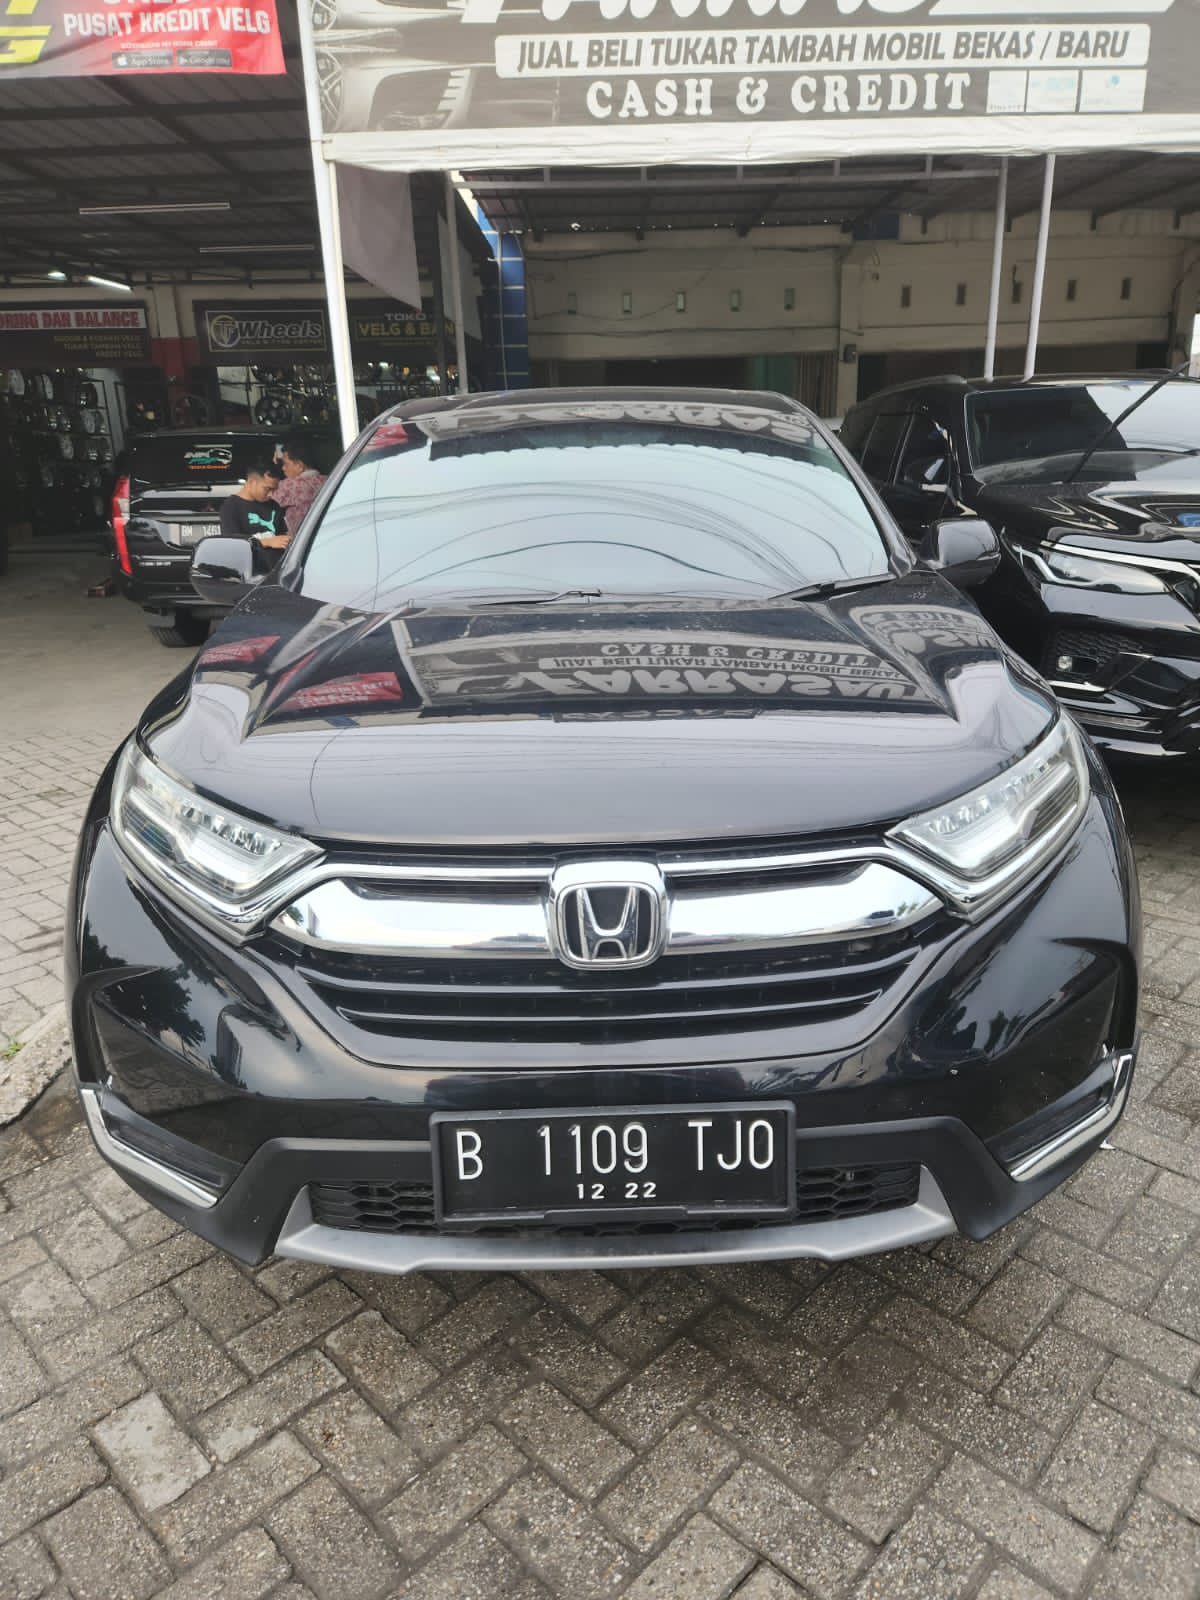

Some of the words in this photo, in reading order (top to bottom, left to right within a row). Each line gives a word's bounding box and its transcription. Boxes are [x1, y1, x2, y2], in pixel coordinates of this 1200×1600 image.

[63, 12, 132, 37] PUSAT
[140, 7, 211, 33] KREDIT
[215, 7, 271, 34] VELG
[517, 40, 578, 72] JUAL
[586, 38, 643, 68] BELI
[650, 36, 738, 66] TUKAR
[745, 33, 857, 65] TAMBAH
[863, 32, 946, 62] MOBIL
[953, 30, 1035, 60] BEKAS
[1055, 30, 1131, 58] BARU
[586, 77, 713, 119] CASH
[735, 76, 769, 115] &
[790, 72, 971, 114] CREDIT
[42, 311, 71, 328] DAN
[75, 311, 140, 328] BALANCE
[384, 312, 426, 321] TOKO
[239, 319, 323, 339] Wheels
[359, 321, 401, 337] VELG
[456, 1130, 483, 1181] B
[536, 1122, 648, 1176] 1109
[687, 1119, 775, 1171] TJO
[576, 1183, 605, 1200] 12
[624, 1181, 657, 1199] 22
